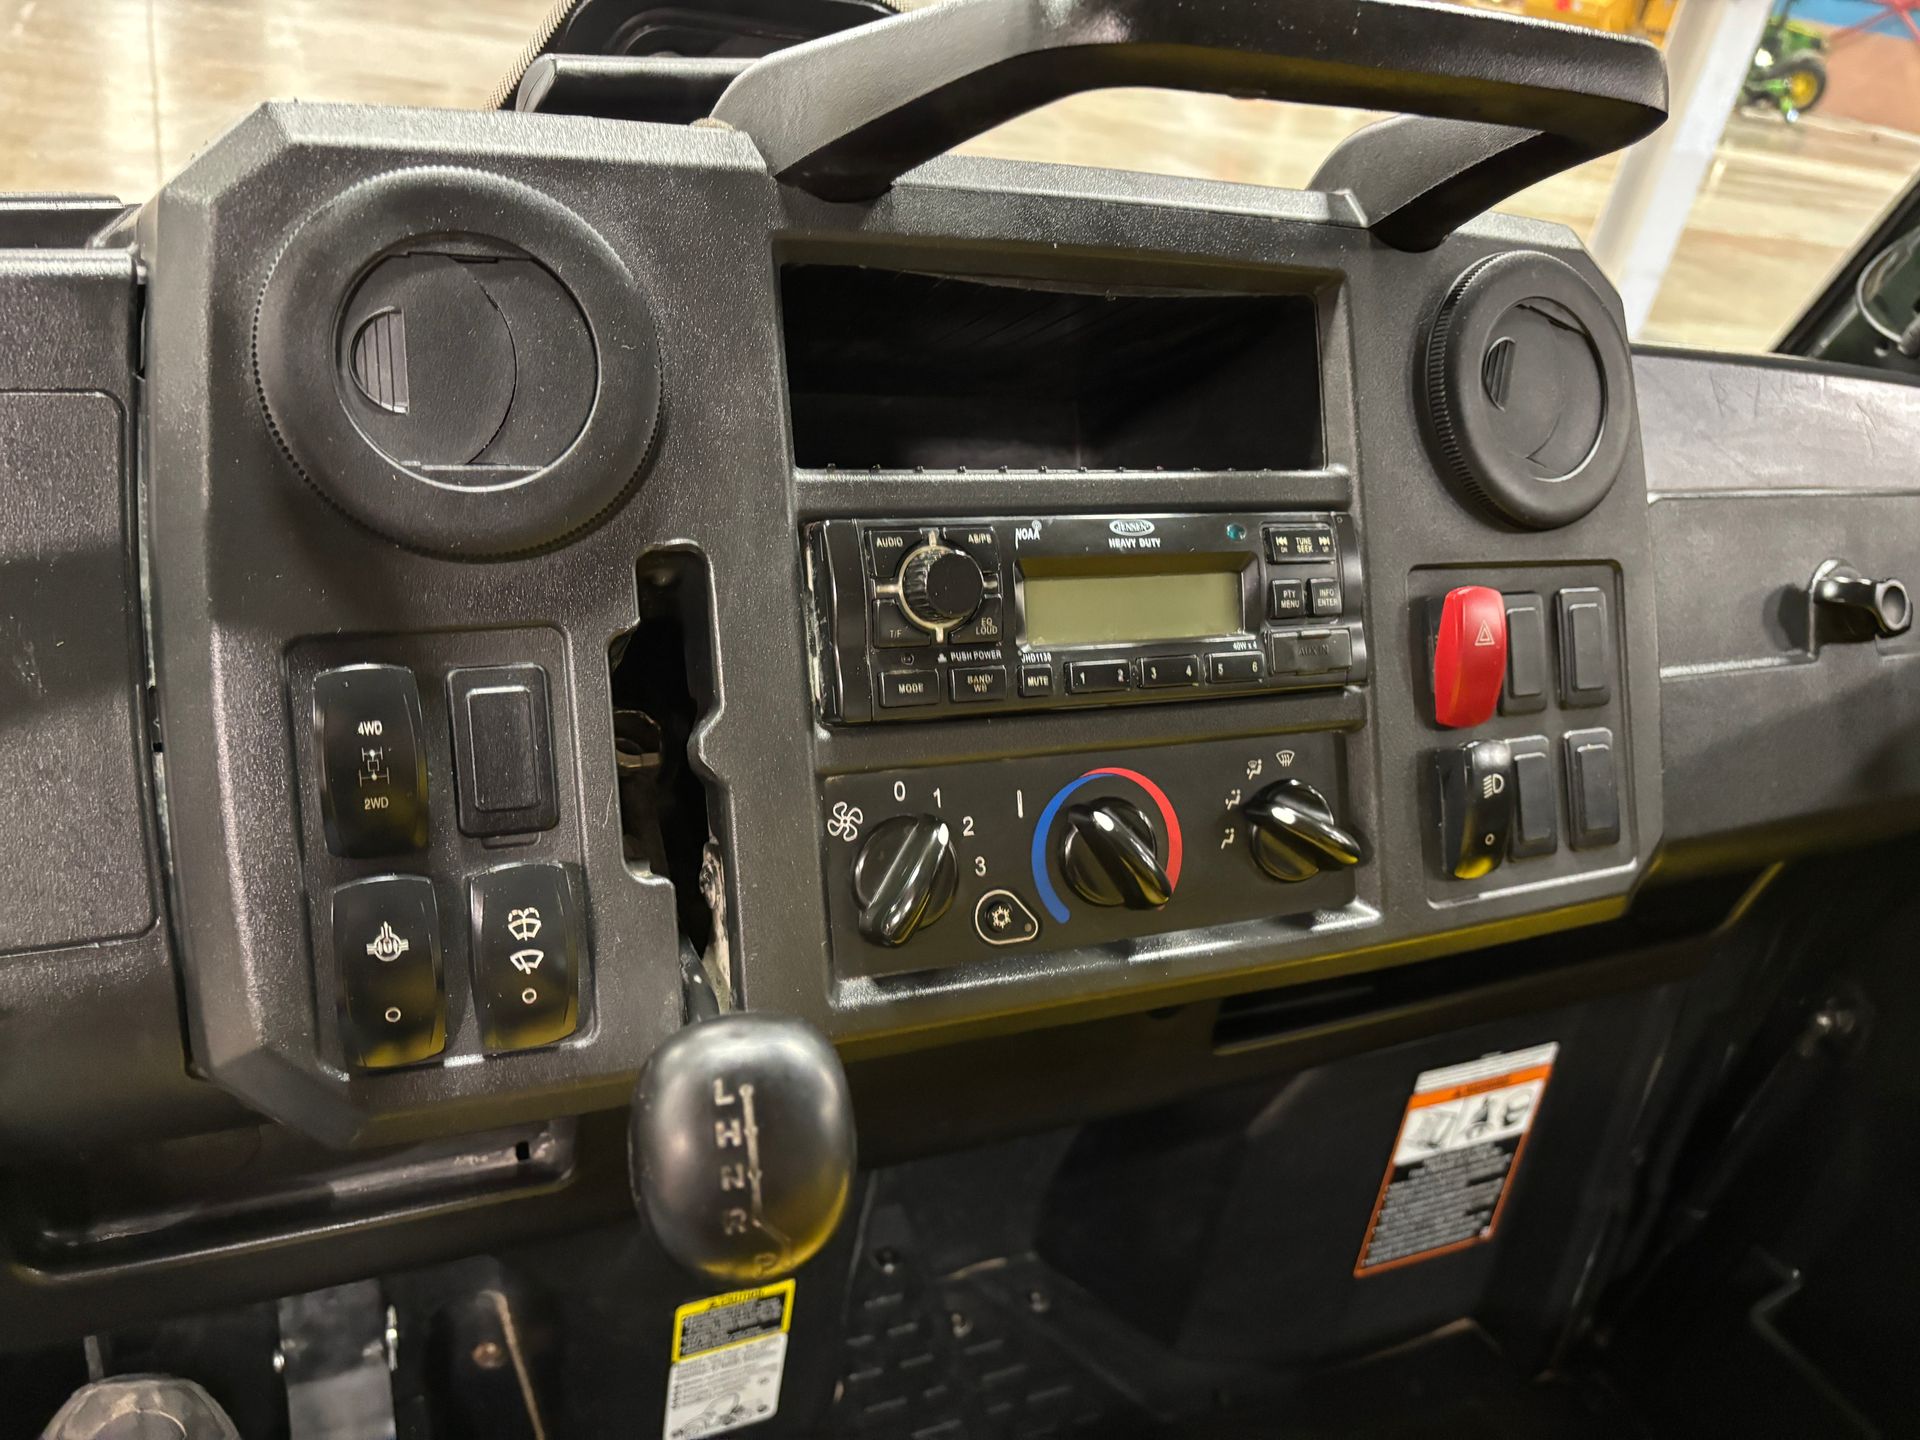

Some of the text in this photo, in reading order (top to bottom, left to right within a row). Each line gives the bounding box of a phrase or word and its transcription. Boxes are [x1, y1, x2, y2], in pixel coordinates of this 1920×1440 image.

[876, 537, 904, 548] AUDIO
[1015, 528, 1041, 551] NOAA
[1108, 537, 1161, 549] HEAVY DUTY
[1295, 537, 1312, 545] TUNE
[1297, 544, 1314, 553] SEEK
[1283, 589, 1296, 598] PTY
[1319, 588, 1335, 597] INFO
[1280, 599, 1300, 609] MENU
[1317, 598, 1339, 607] ENTER
[981, 617, 992, 626] EQ
[889, 629, 902, 639] T/F
[975, 624, 998, 635] LOUD
[950, 649, 1002, 662] PUSH POWER
[1298, 643, 1329, 657] AUX IN
[1151, 666, 1157, 679] 3
[1185, 664, 1192, 677] 4
[1218, 663, 1224, 676] 5
[1252, 661, 1258, 673] 6
[967, 675, 993, 685] BAND/
[1027, 675, 1049, 687] MUTE
[1079, 672, 1086, 684] 1
[1117, 669, 1124, 682] 2
[898, 683, 924, 693] MODE
[358, 720, 383, 736] 4WD
[893, 781, 906, 801] 0
[364, 796, 390, 810] 2WD
[932, 787, 942, 808] 1
[962, 816, 975, 836] 2
[974, 856, 987, 877] 3
[714, 1078, 734, 1106] L
[715, 1118, 743, 1148] H
[720, 1163, 746, 1192] N
